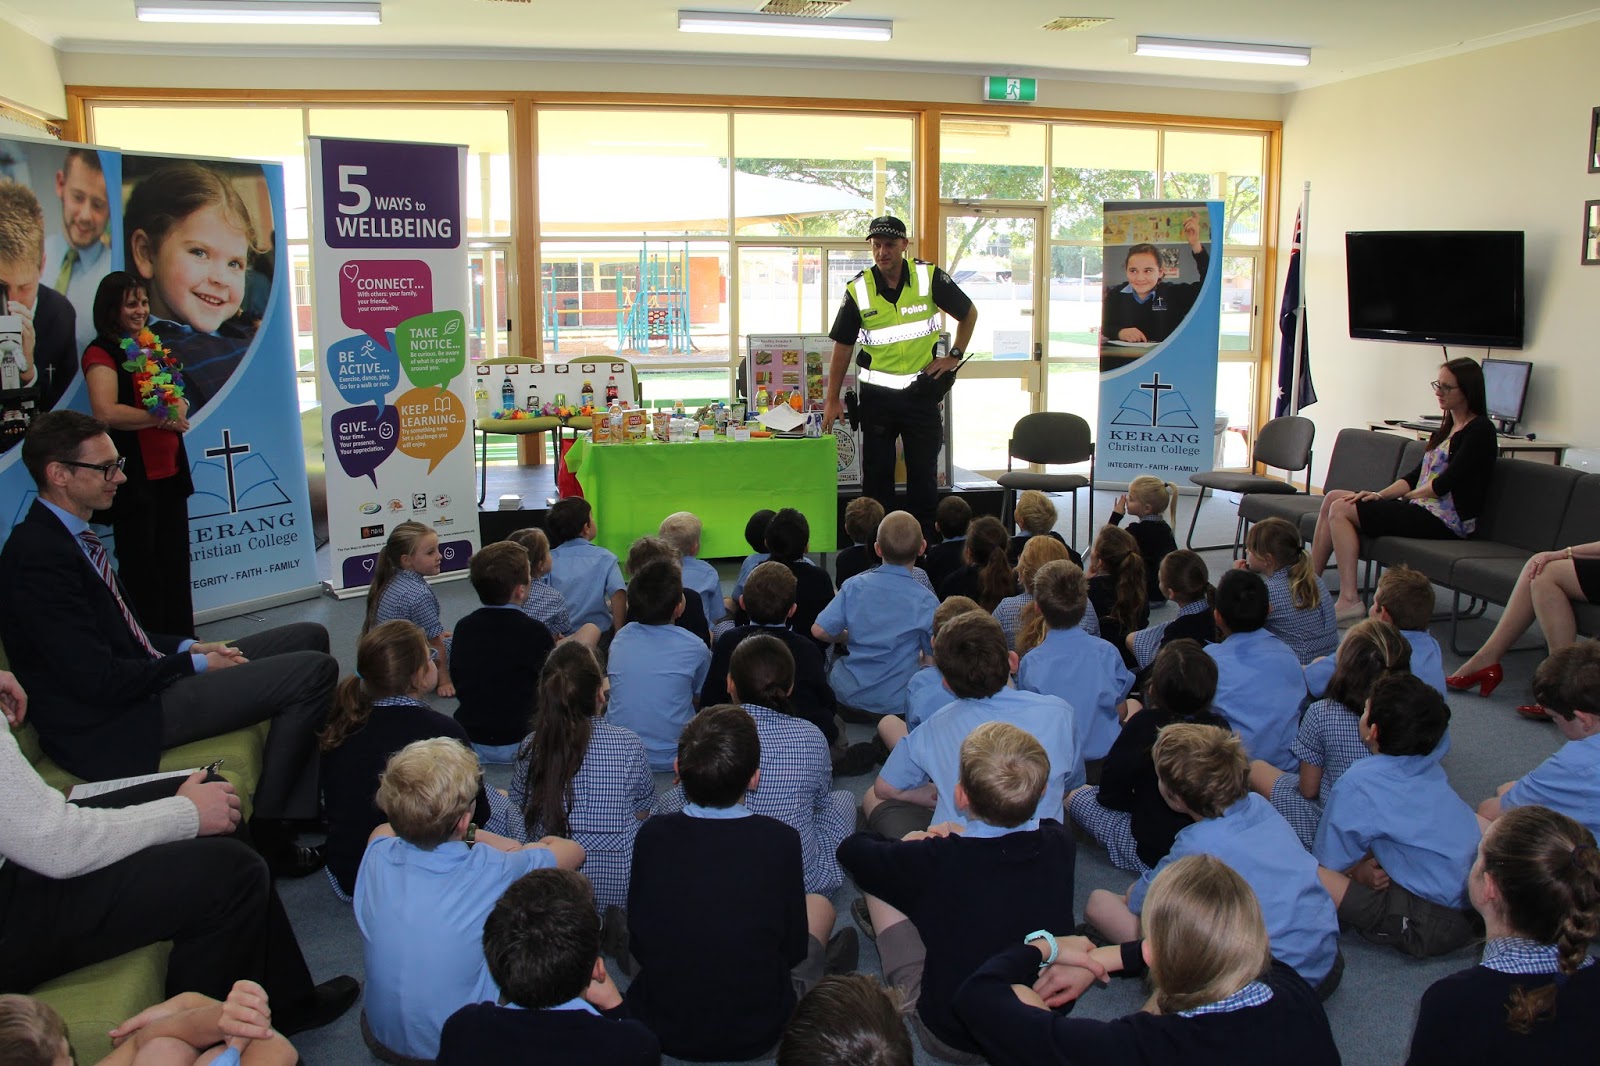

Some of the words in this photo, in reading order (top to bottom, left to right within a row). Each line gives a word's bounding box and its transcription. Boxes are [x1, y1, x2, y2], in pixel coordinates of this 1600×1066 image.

[338, 165, 371, 215] 5
[375, 197, 412, 211] WAYS
[415, 202, 426, 211] to
[336, 217, 451, 238] WELLBEING
[357, 278, 424, 290] CONNECT...
[901, 304, 927, 315] Police
[410, 328, 438, 338] TAKE
[410, 339, 460, 350] NOTICE...
[339, 352, 354, 362] BE
[339, 363, 389, 375] ACTIVE...
[402, 404, 428, 415] KEEP
[402, 414, 464, 427] LEARNING...
[340, 422, 376, 433] GIVE...
[1110, 431, 1200, 444] KERANG
[353, 446, 385, 454] appreciation.
[1108, 442, 1156, 453] Christian
[1161, 445, 1200, 456] College
[249, 532, 298, 550] College
[236, 567, 262, 580] FAITH
[270, 559, 300, 573] FAMILY
